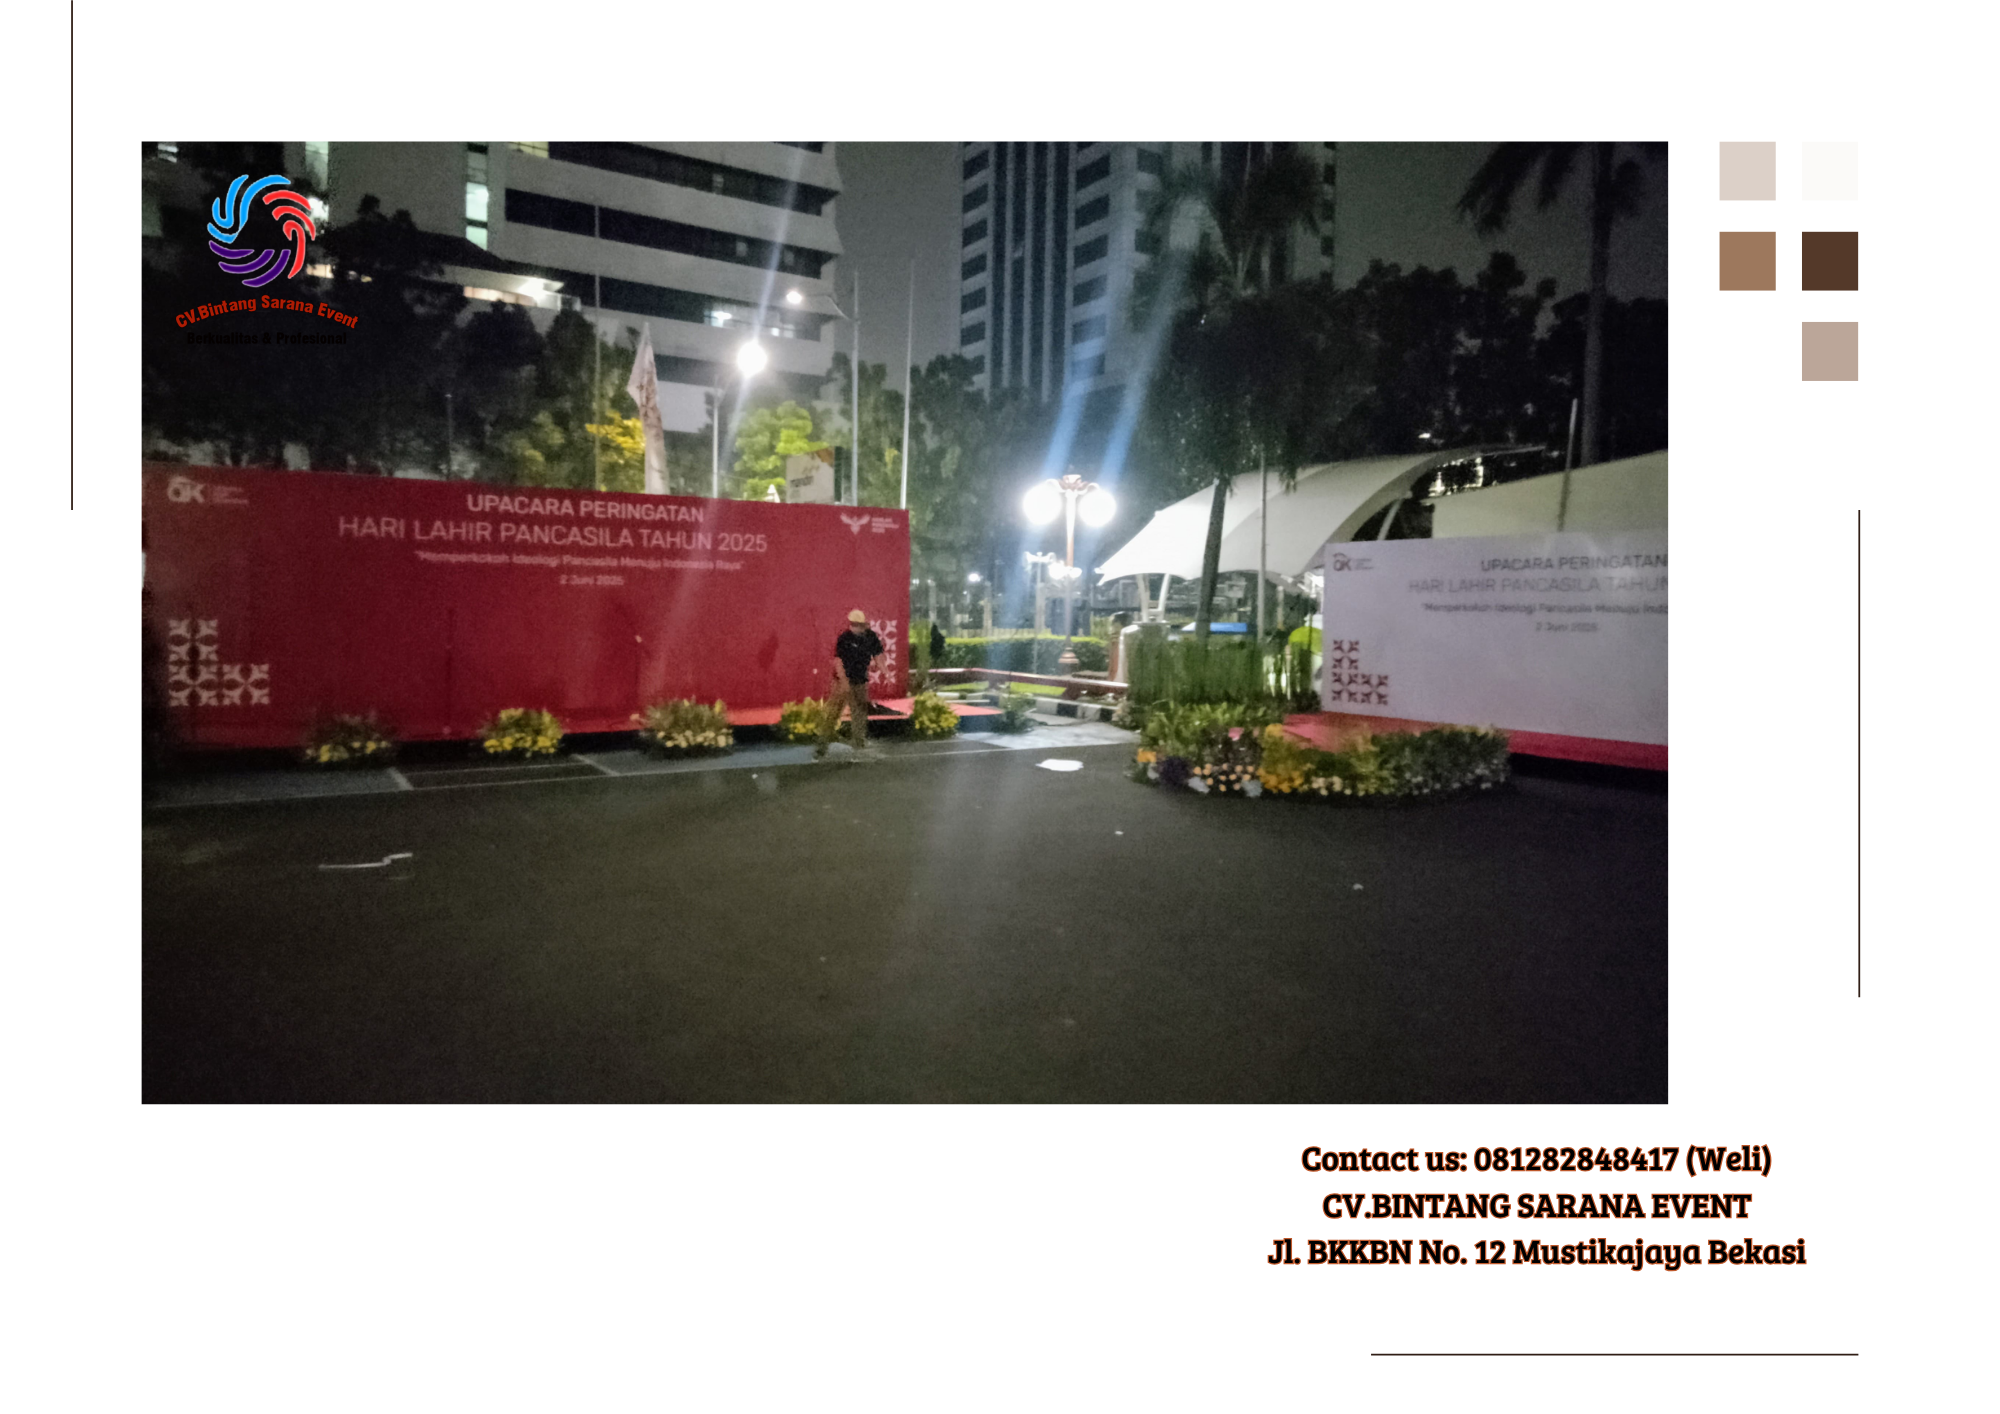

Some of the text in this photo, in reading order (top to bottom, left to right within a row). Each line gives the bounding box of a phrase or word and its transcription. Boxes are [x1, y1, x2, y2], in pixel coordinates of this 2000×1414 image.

[467, 493, 704, 522] UPACARA PERINGATAN
[338, 516, 768, 552] HARI LAHIR PANCASILA TAHUN 2025
[1481, 554, 1668, 571] UPACARA PERINGATAN
[1408, 579, 1443, 593] HARI
[1448, 578, 1496, 593] LAHIR
[1502, 576, 1599, 593] PANCASILA
